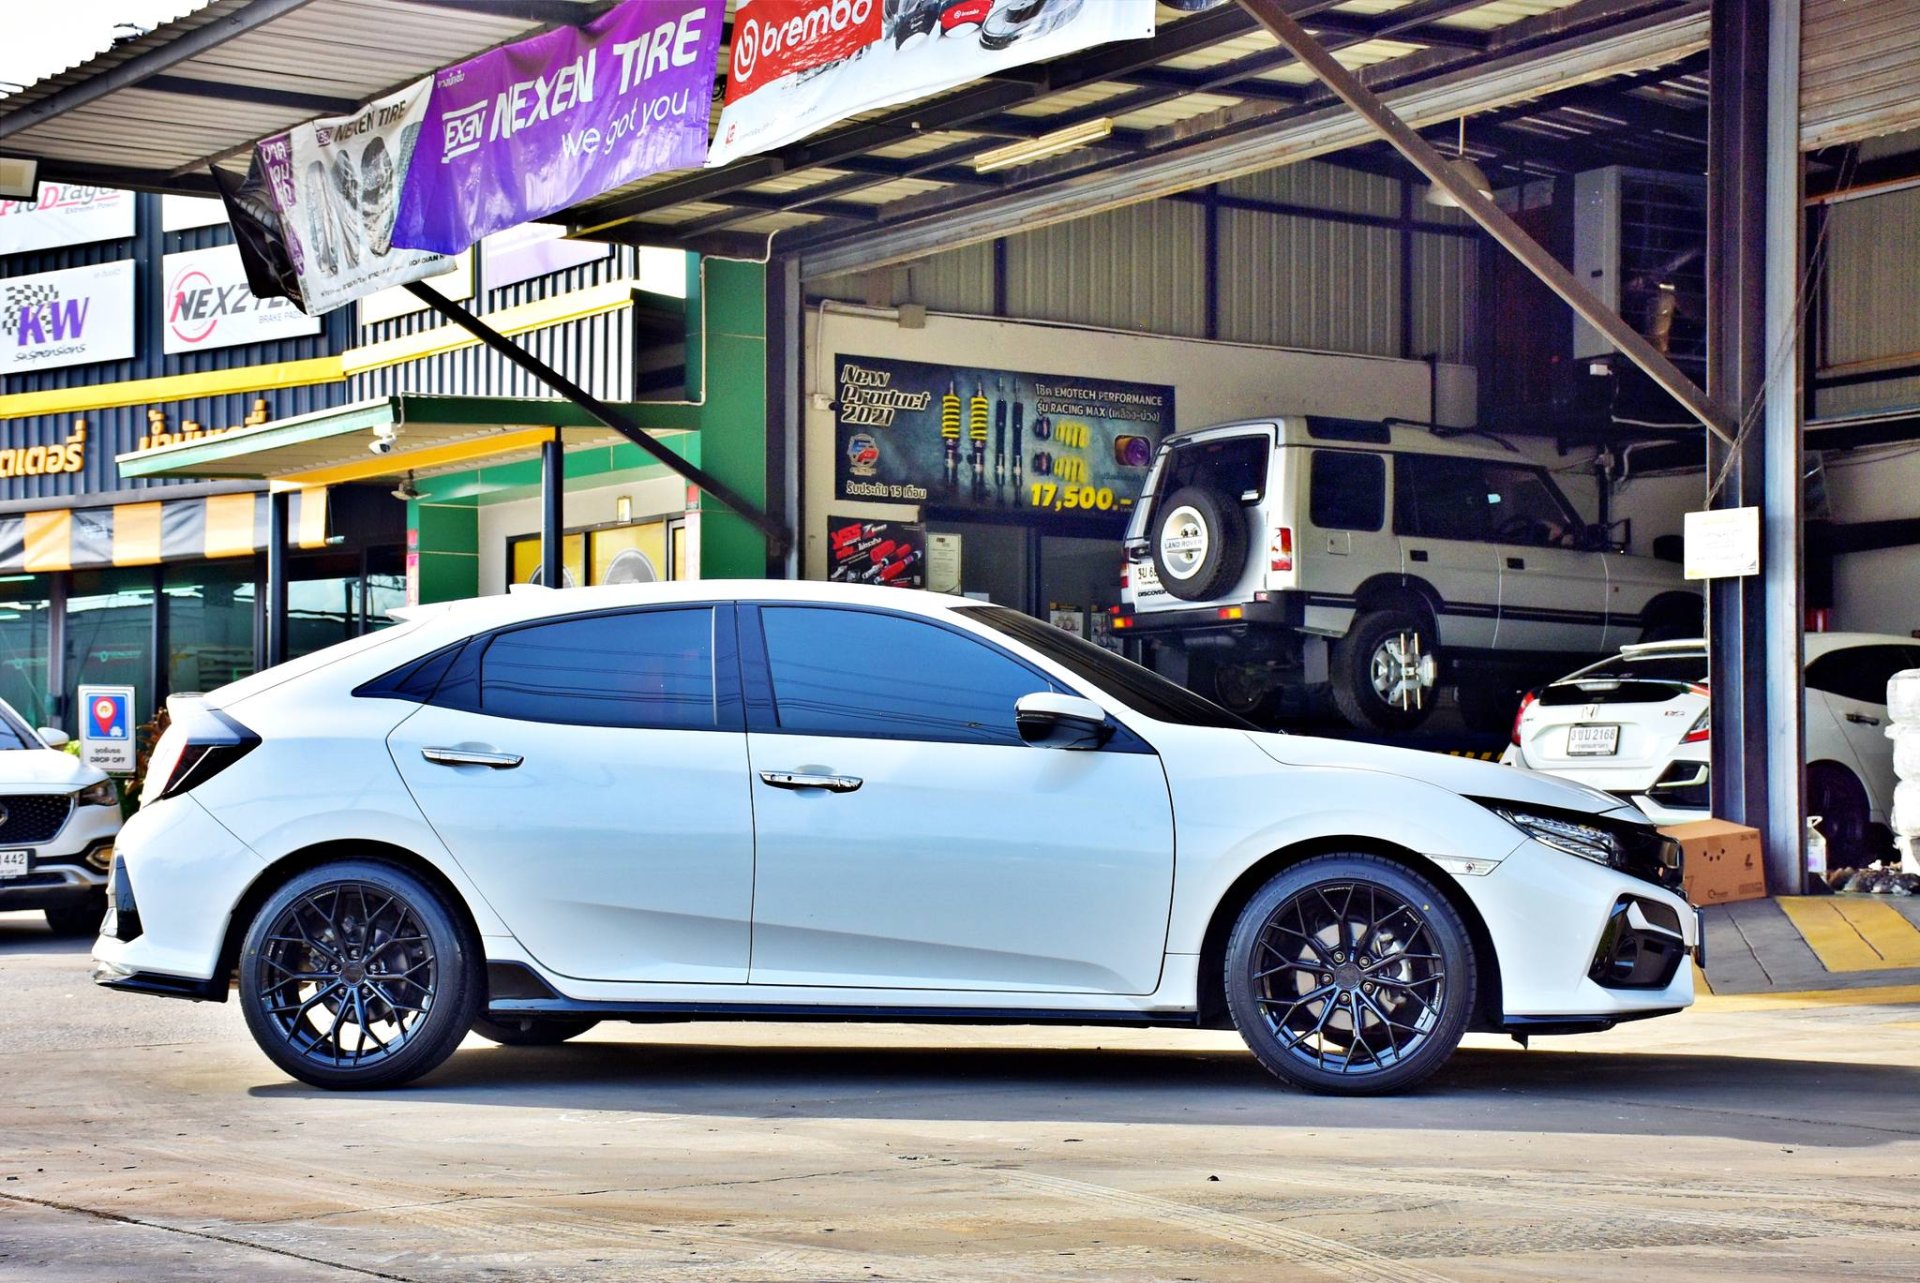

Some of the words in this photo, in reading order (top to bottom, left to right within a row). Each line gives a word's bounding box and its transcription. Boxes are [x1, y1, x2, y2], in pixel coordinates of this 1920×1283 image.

[761, 0, 873, 58] brembo
[489, 47, 597, 143] NEXEN
[612, 7, 707, 96] TIRE
[378, 99, 407, 128] TIRE
[561, 127, 601, 160] we
[605, 99, 639, 155] got
[636, 88, 690, 139] you
[18, 297, 90, 346] KW
[259, 314, 283, 325] BRAKE
[841, 364, 891, 387] New
[841, 384, 931, 411] Product
[1054, 387, 1096, 401] EMOTECH
[1098, 391, 1163, 406] PERFORMANCE
[841, 404, 895, 426] 2021
[1050, 403, 1084, 416] RACING
[1086, 407, 1106, 417] MAX
[846, 480, 888, 497] รับประกัน
[890, 485, 902, 497] 15
[903, 484, 927, 499] เดือน
[1164, 541, 1180, 549] LAND
[1182, 539, 1202, 548] ROVER
[1592, 728, 1616, 741] 2168
